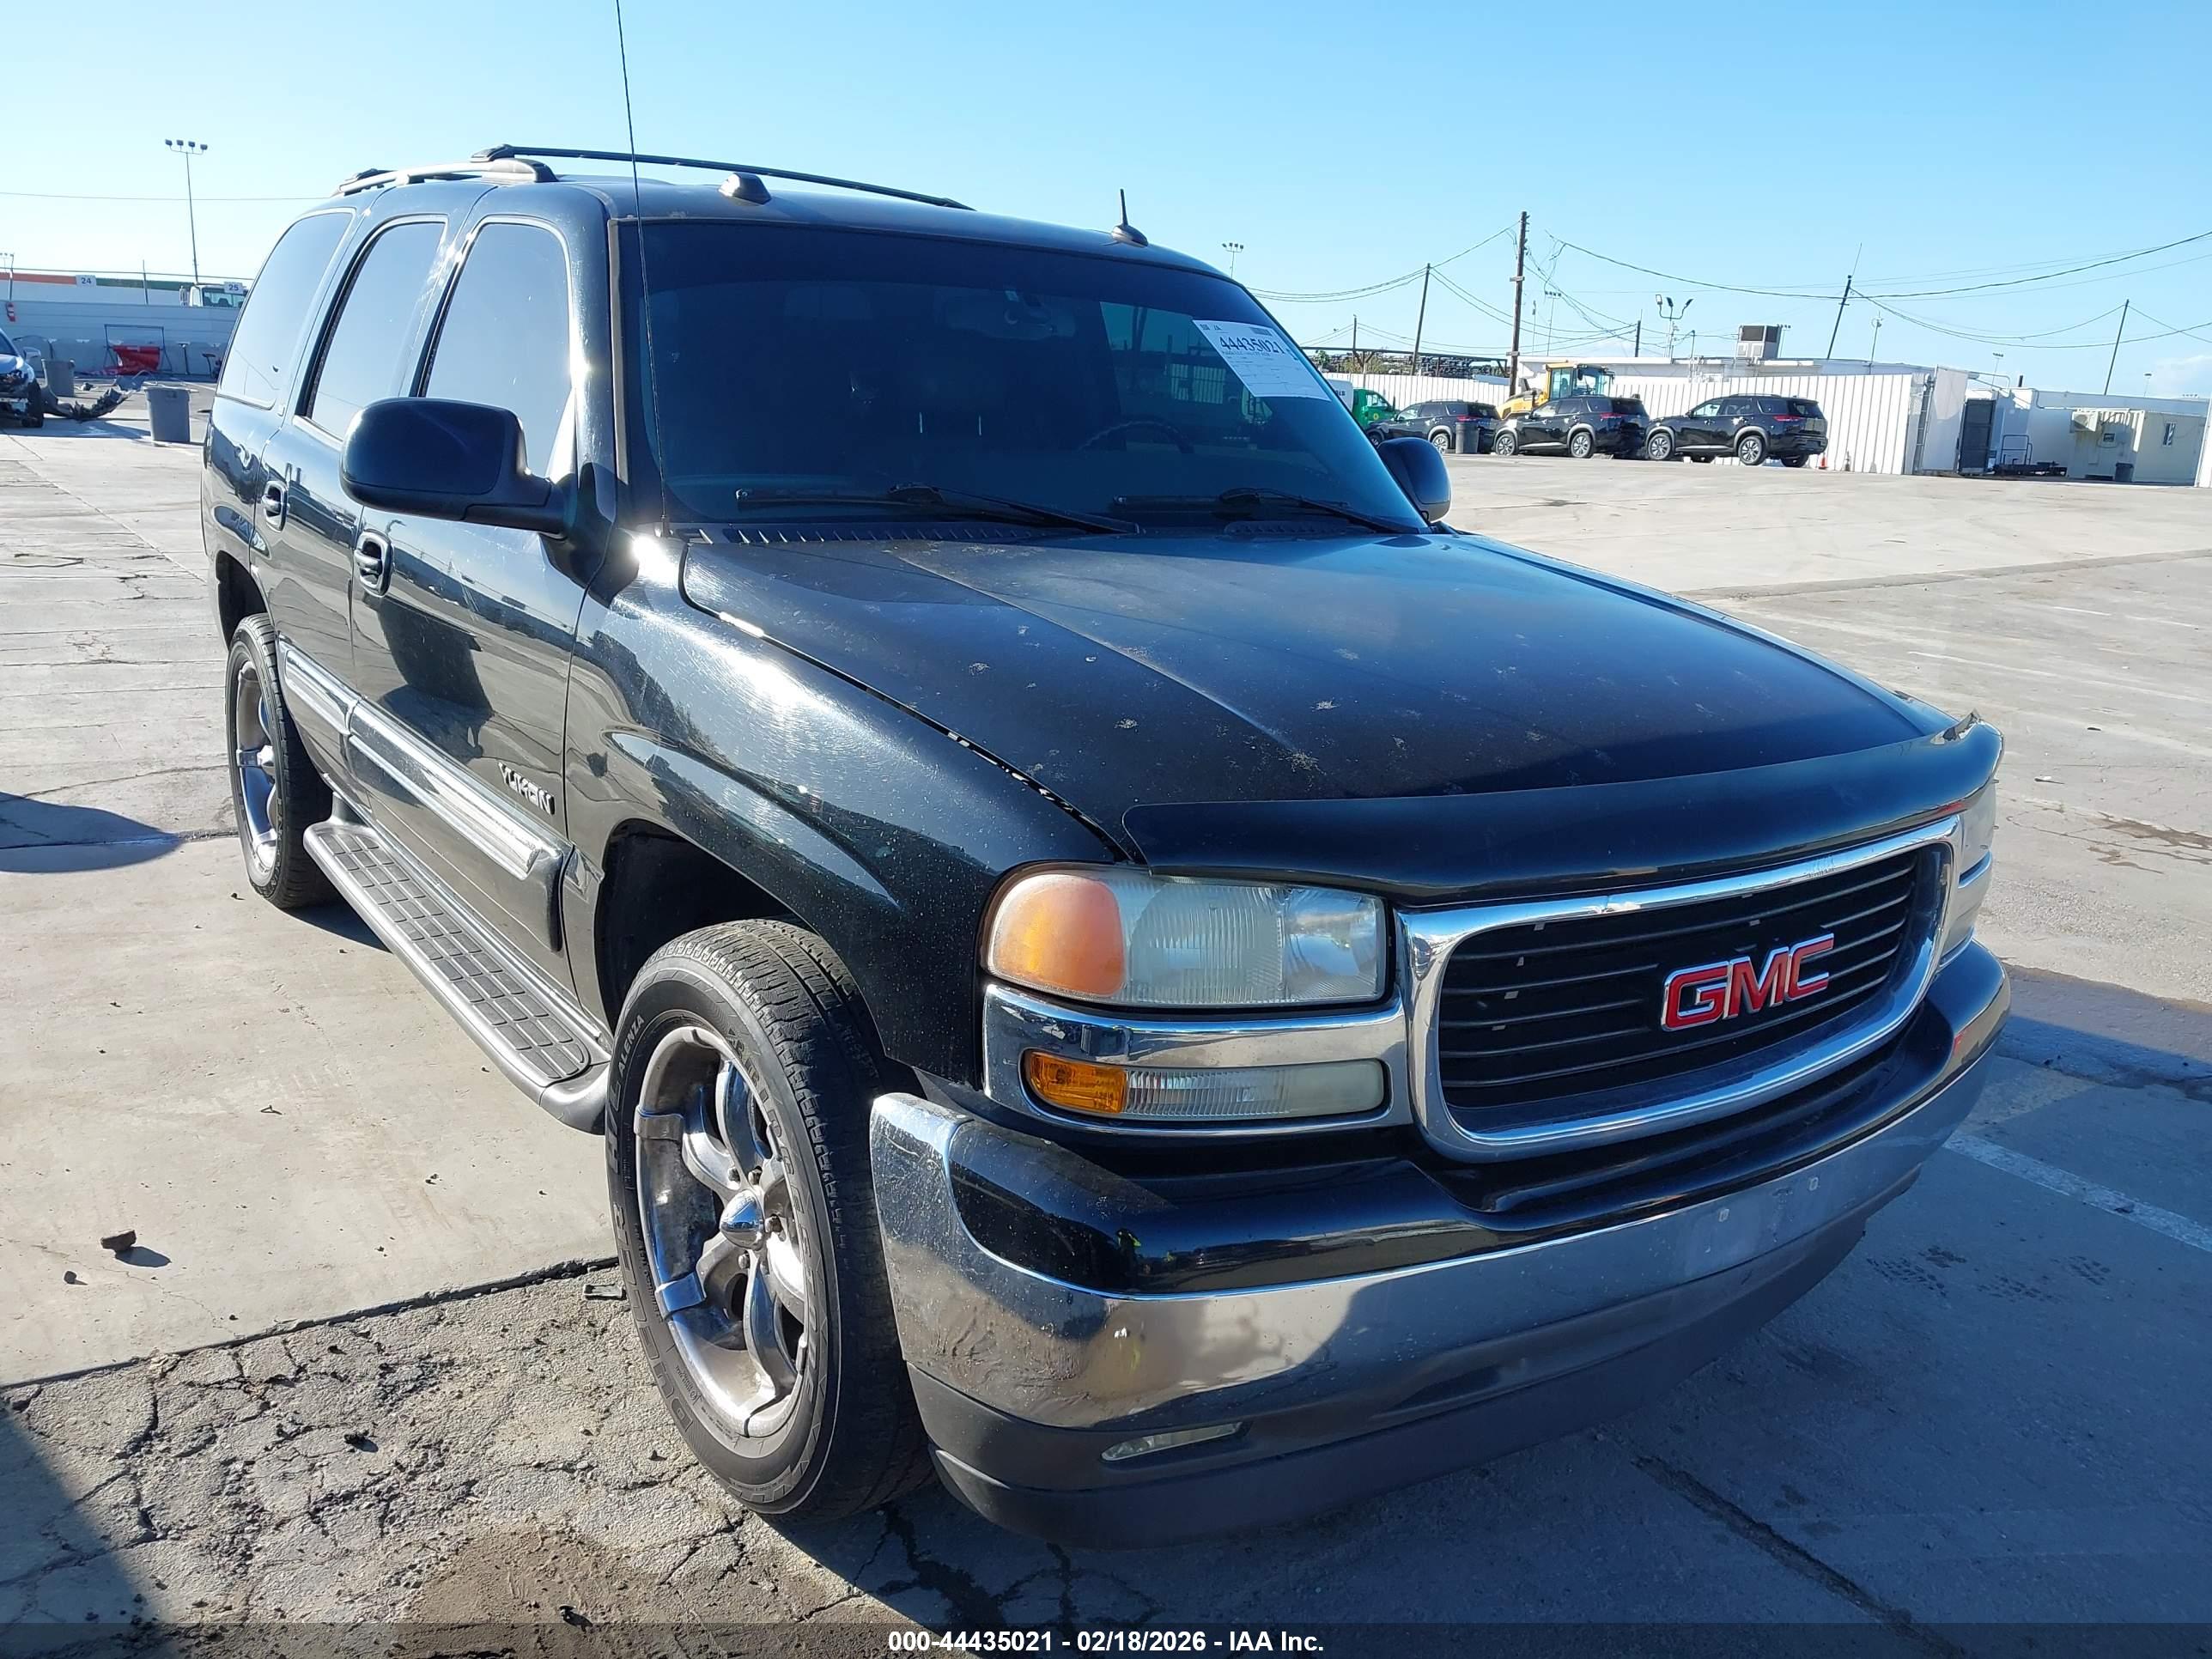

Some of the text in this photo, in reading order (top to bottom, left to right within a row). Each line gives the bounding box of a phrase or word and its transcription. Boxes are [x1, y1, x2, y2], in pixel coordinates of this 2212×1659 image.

[1219, 336, 1285, 354] 44435021
[498, 762, 556, 815] YUKON
[1661, 933, 1834, 1031] GMC
[618, 1014, 645, 1079] ALENZA
